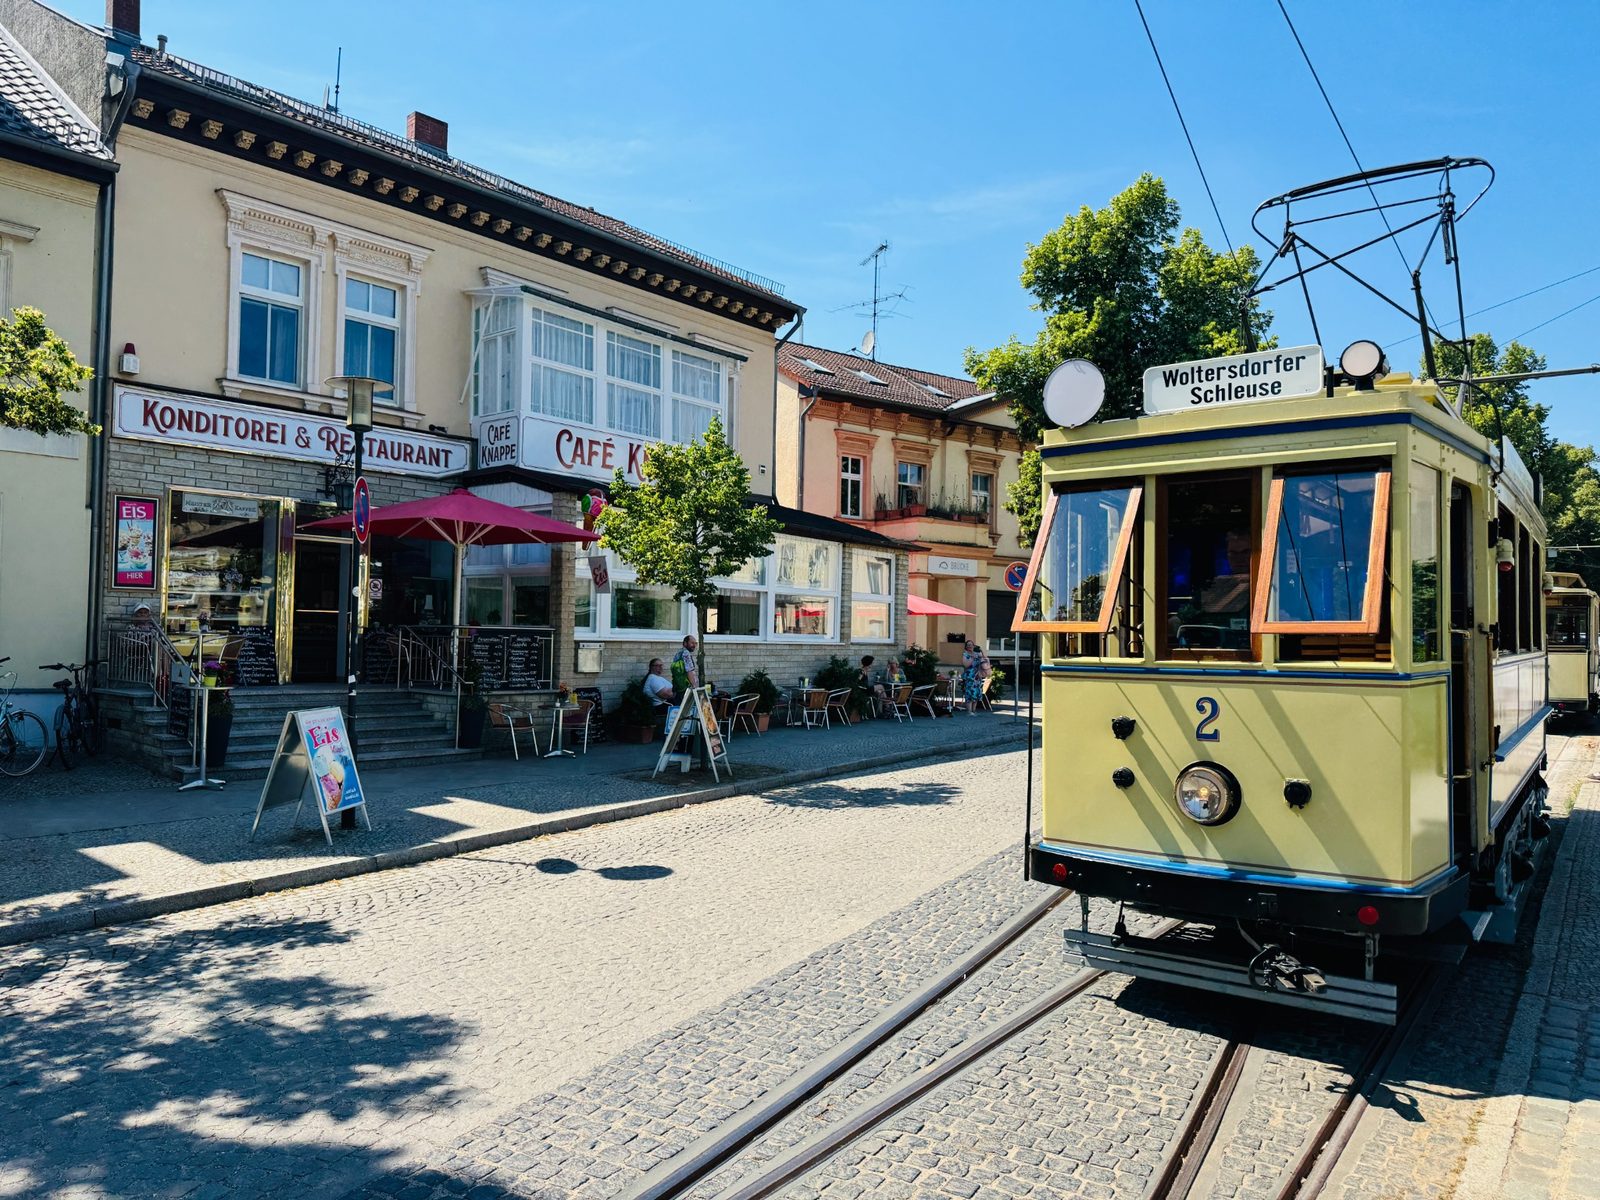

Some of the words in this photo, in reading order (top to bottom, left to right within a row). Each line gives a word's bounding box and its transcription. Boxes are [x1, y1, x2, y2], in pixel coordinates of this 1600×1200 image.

[1162, 354, 1306, 388] Woltersdorfer
[1190, 380, 1282, 405] Schleuse
[142, 399, 287, 446] KONDITOREI
[295, 426, 311, 449] &
[317, 426, 454, 469] RETAURANT
[487, 421, 511, 446] CAFÉ
[481, 443, 517, 467] KNAPPE
[555, 428, 616, 470] CAFÉ
[122, 506, 147, 519] EIS
[126, 572, 144, 580] HIER
[1195, 696, 1221, 743] 2
[308, 726, 340, 749] Eis
